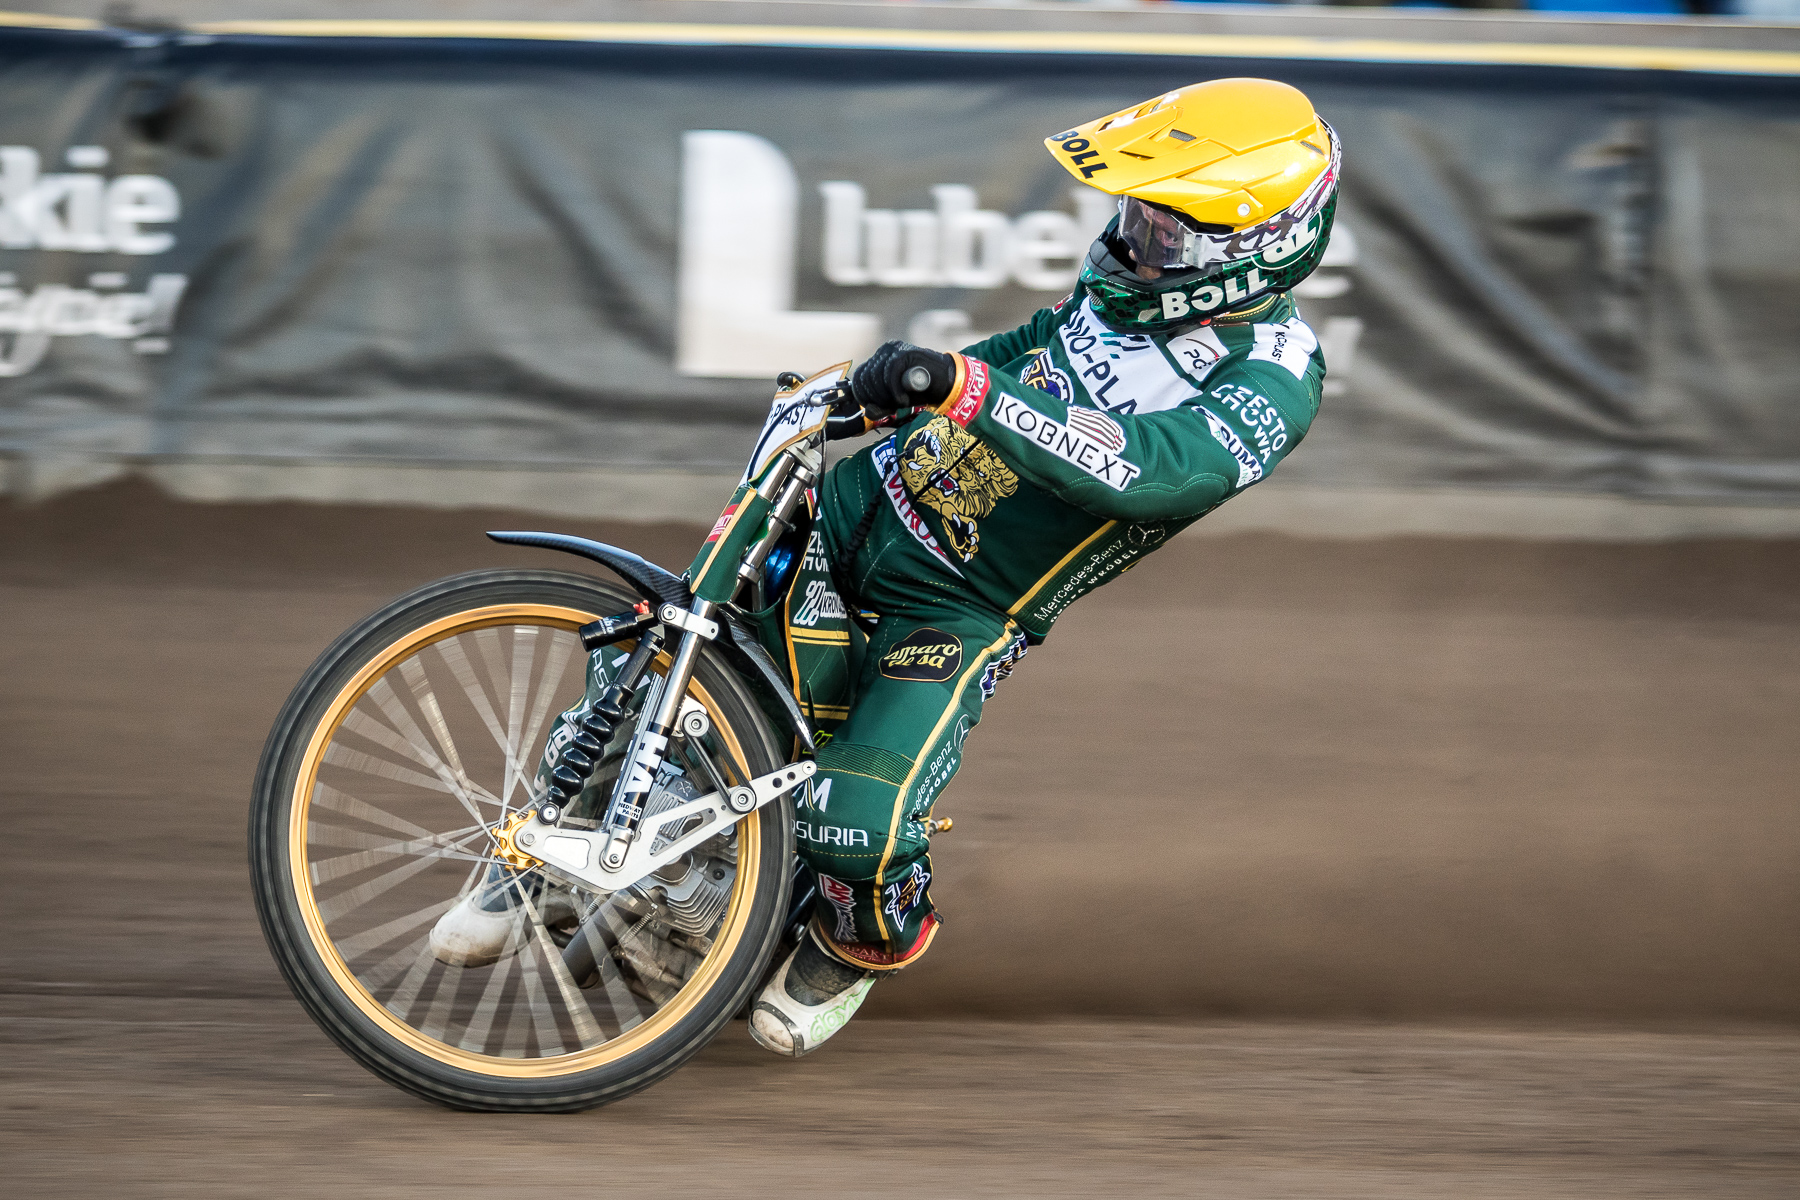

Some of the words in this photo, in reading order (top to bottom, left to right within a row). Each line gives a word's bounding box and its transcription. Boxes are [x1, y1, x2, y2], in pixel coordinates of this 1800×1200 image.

[1049, 130, 1109, 180] BOLL
[1161, 268, 1268, 320] BOLL
[995, 397, 1138, 488] KOBNEXT
[1033, 539, 1124, 621] Mercedes-Benz
